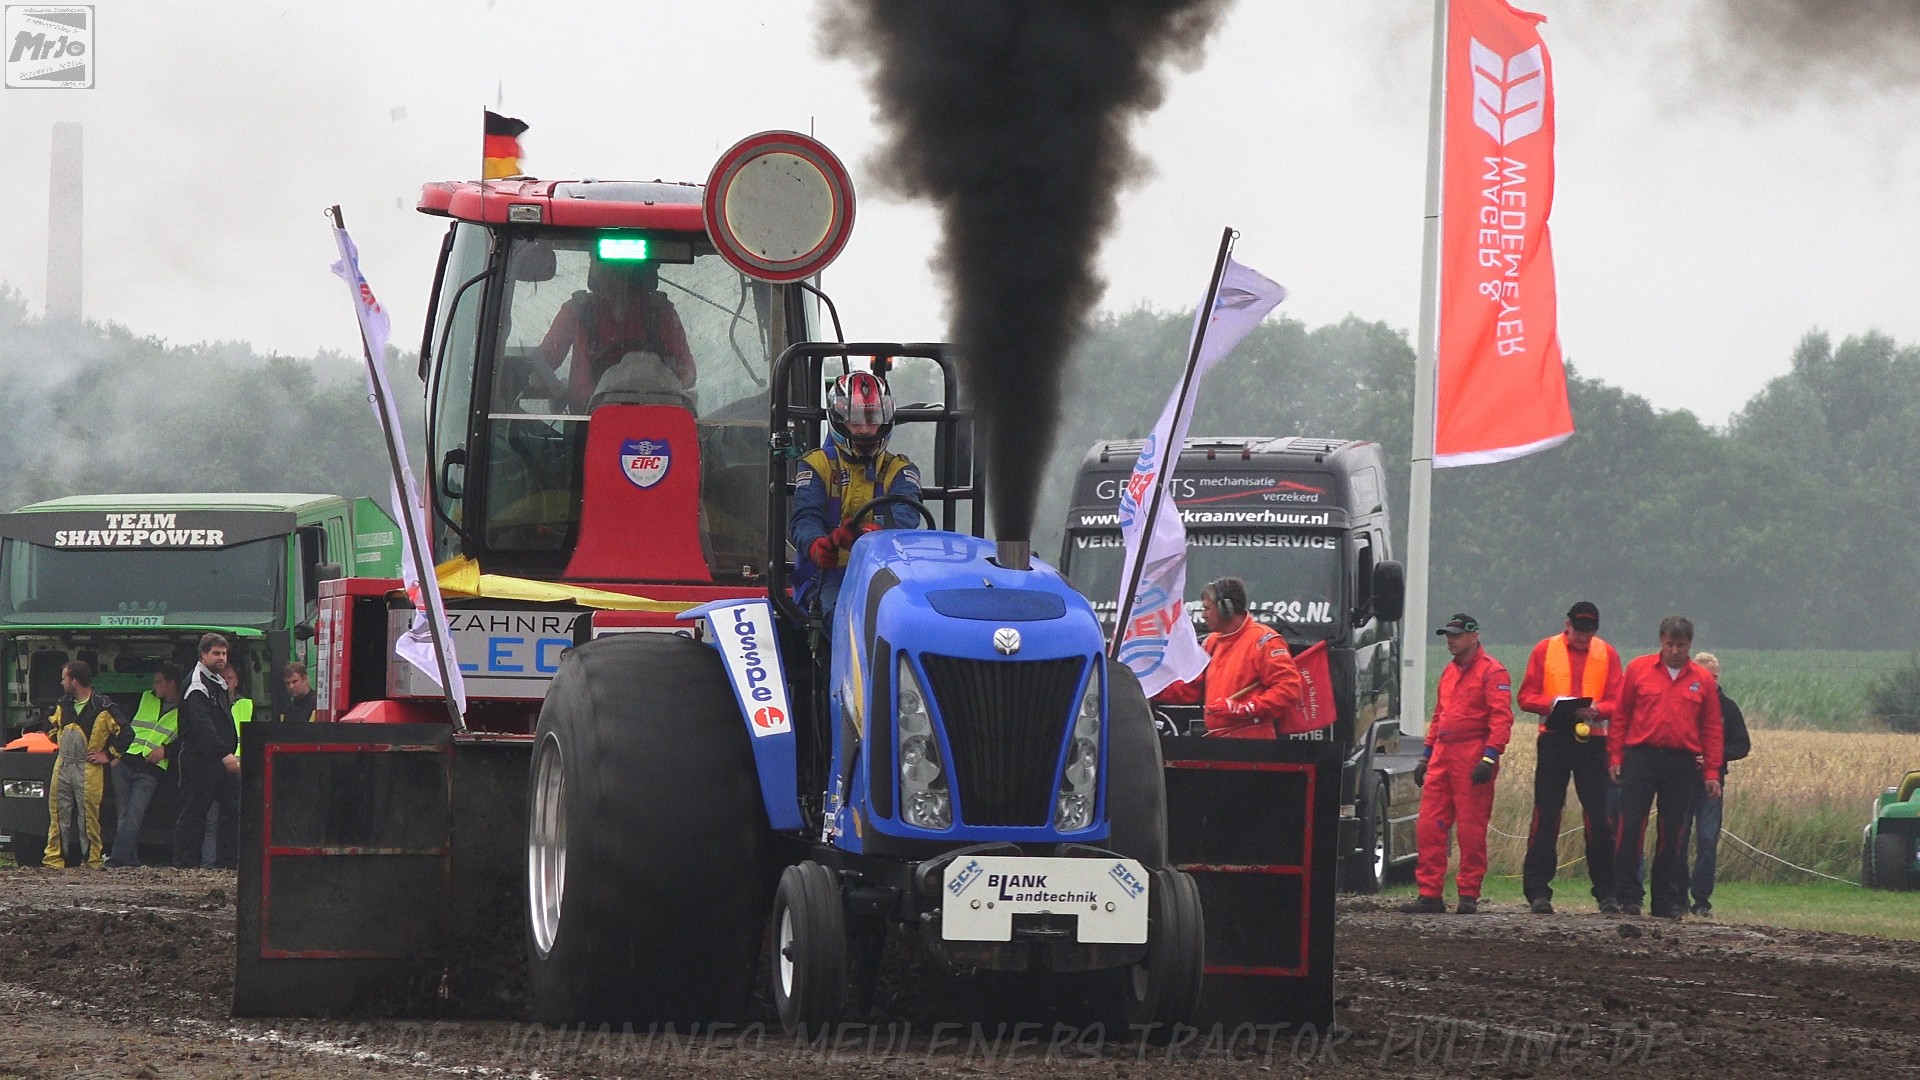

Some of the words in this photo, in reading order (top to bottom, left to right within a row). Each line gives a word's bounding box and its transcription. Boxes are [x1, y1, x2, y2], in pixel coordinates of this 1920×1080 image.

[631, 457, 661, 469] ETPC
[1096, 479, 1195, 499] GETS
[1200, 477, 1275, 487] mechanisatie
[1263, 492, 1319, 502] verzekerd
[106, 513, 177, 529] TEAM
[55, 529, 224, 546] SHAVEPOWER
[1186, 534, 1336, 550] ANDENSERVICE
[446, 614, 575, 633] ZAHNRA
[733, 608, 773, 702] rasspe
[988, 874, 1047, 894] BLANK
